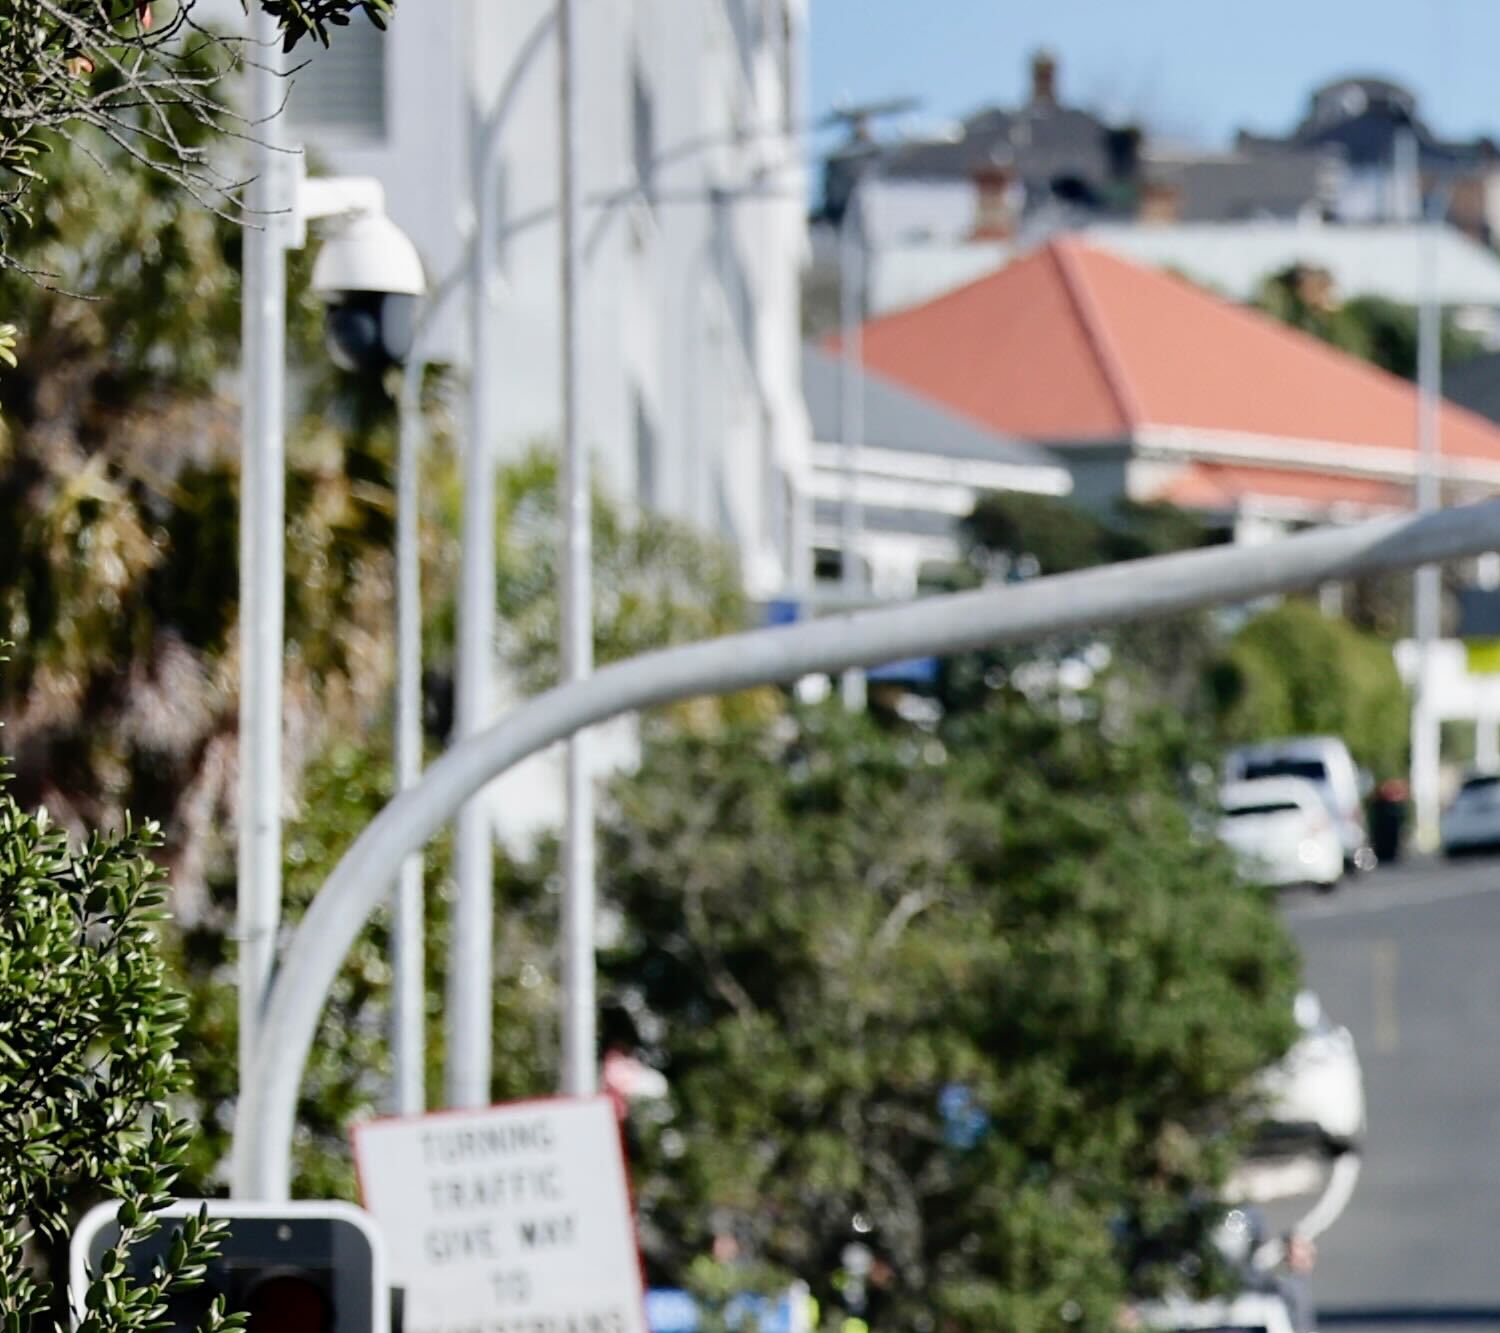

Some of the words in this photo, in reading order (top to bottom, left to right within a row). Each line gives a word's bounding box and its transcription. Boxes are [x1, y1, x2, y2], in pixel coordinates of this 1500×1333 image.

[421, 1119, 553, 1163] TURNING
[430, 1166, 564, 1209] TRAFFIC
[425, 1221, 498, 1265] GIVE
[519, 1212, 575, 1250] WAY
[492, 1267, 532, 1304] TO
